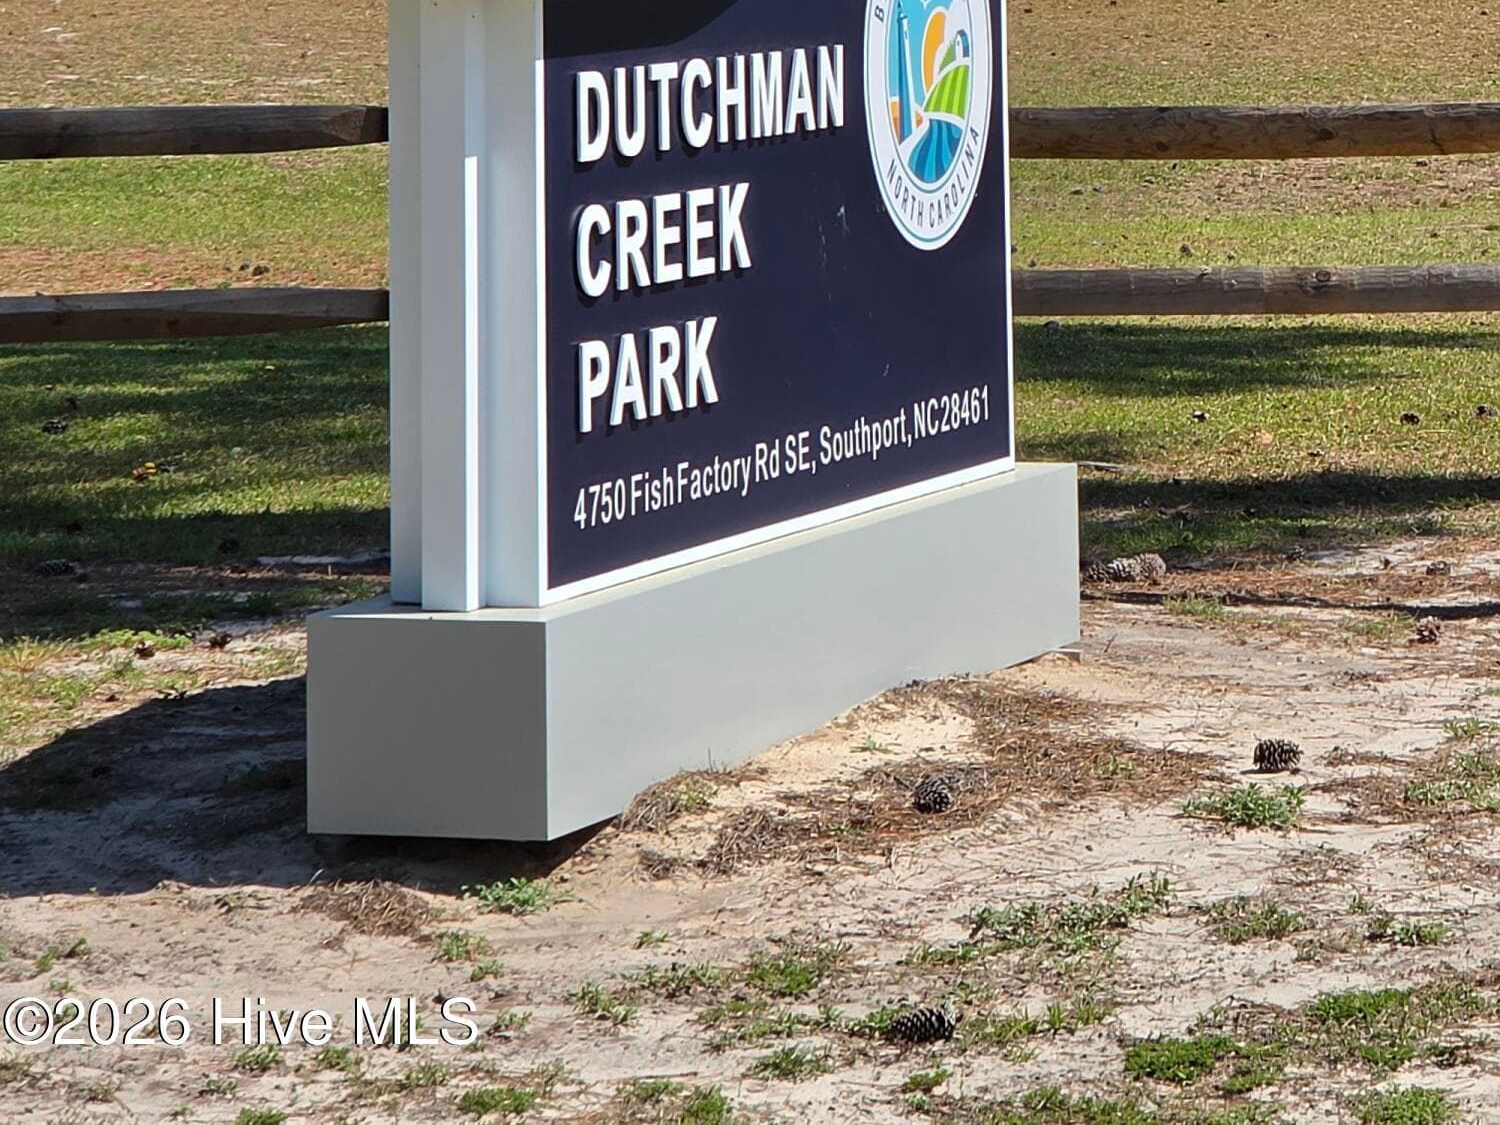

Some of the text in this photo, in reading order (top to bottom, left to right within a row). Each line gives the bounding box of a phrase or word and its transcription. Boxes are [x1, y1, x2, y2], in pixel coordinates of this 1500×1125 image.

[576, 43, 845, 163] DUTCHMAN
[887, 125, 979, 229] NORTH CAROLINA
[576, 182, 752, 298] CREEK
[578, 316, 720, 434] PARK
[573, 478, 627, 530] 4750
[754, 441, 780, 483] Rd
[784, 430, 817, 474] SE,
[819, 407, 913, 460] Southport,
